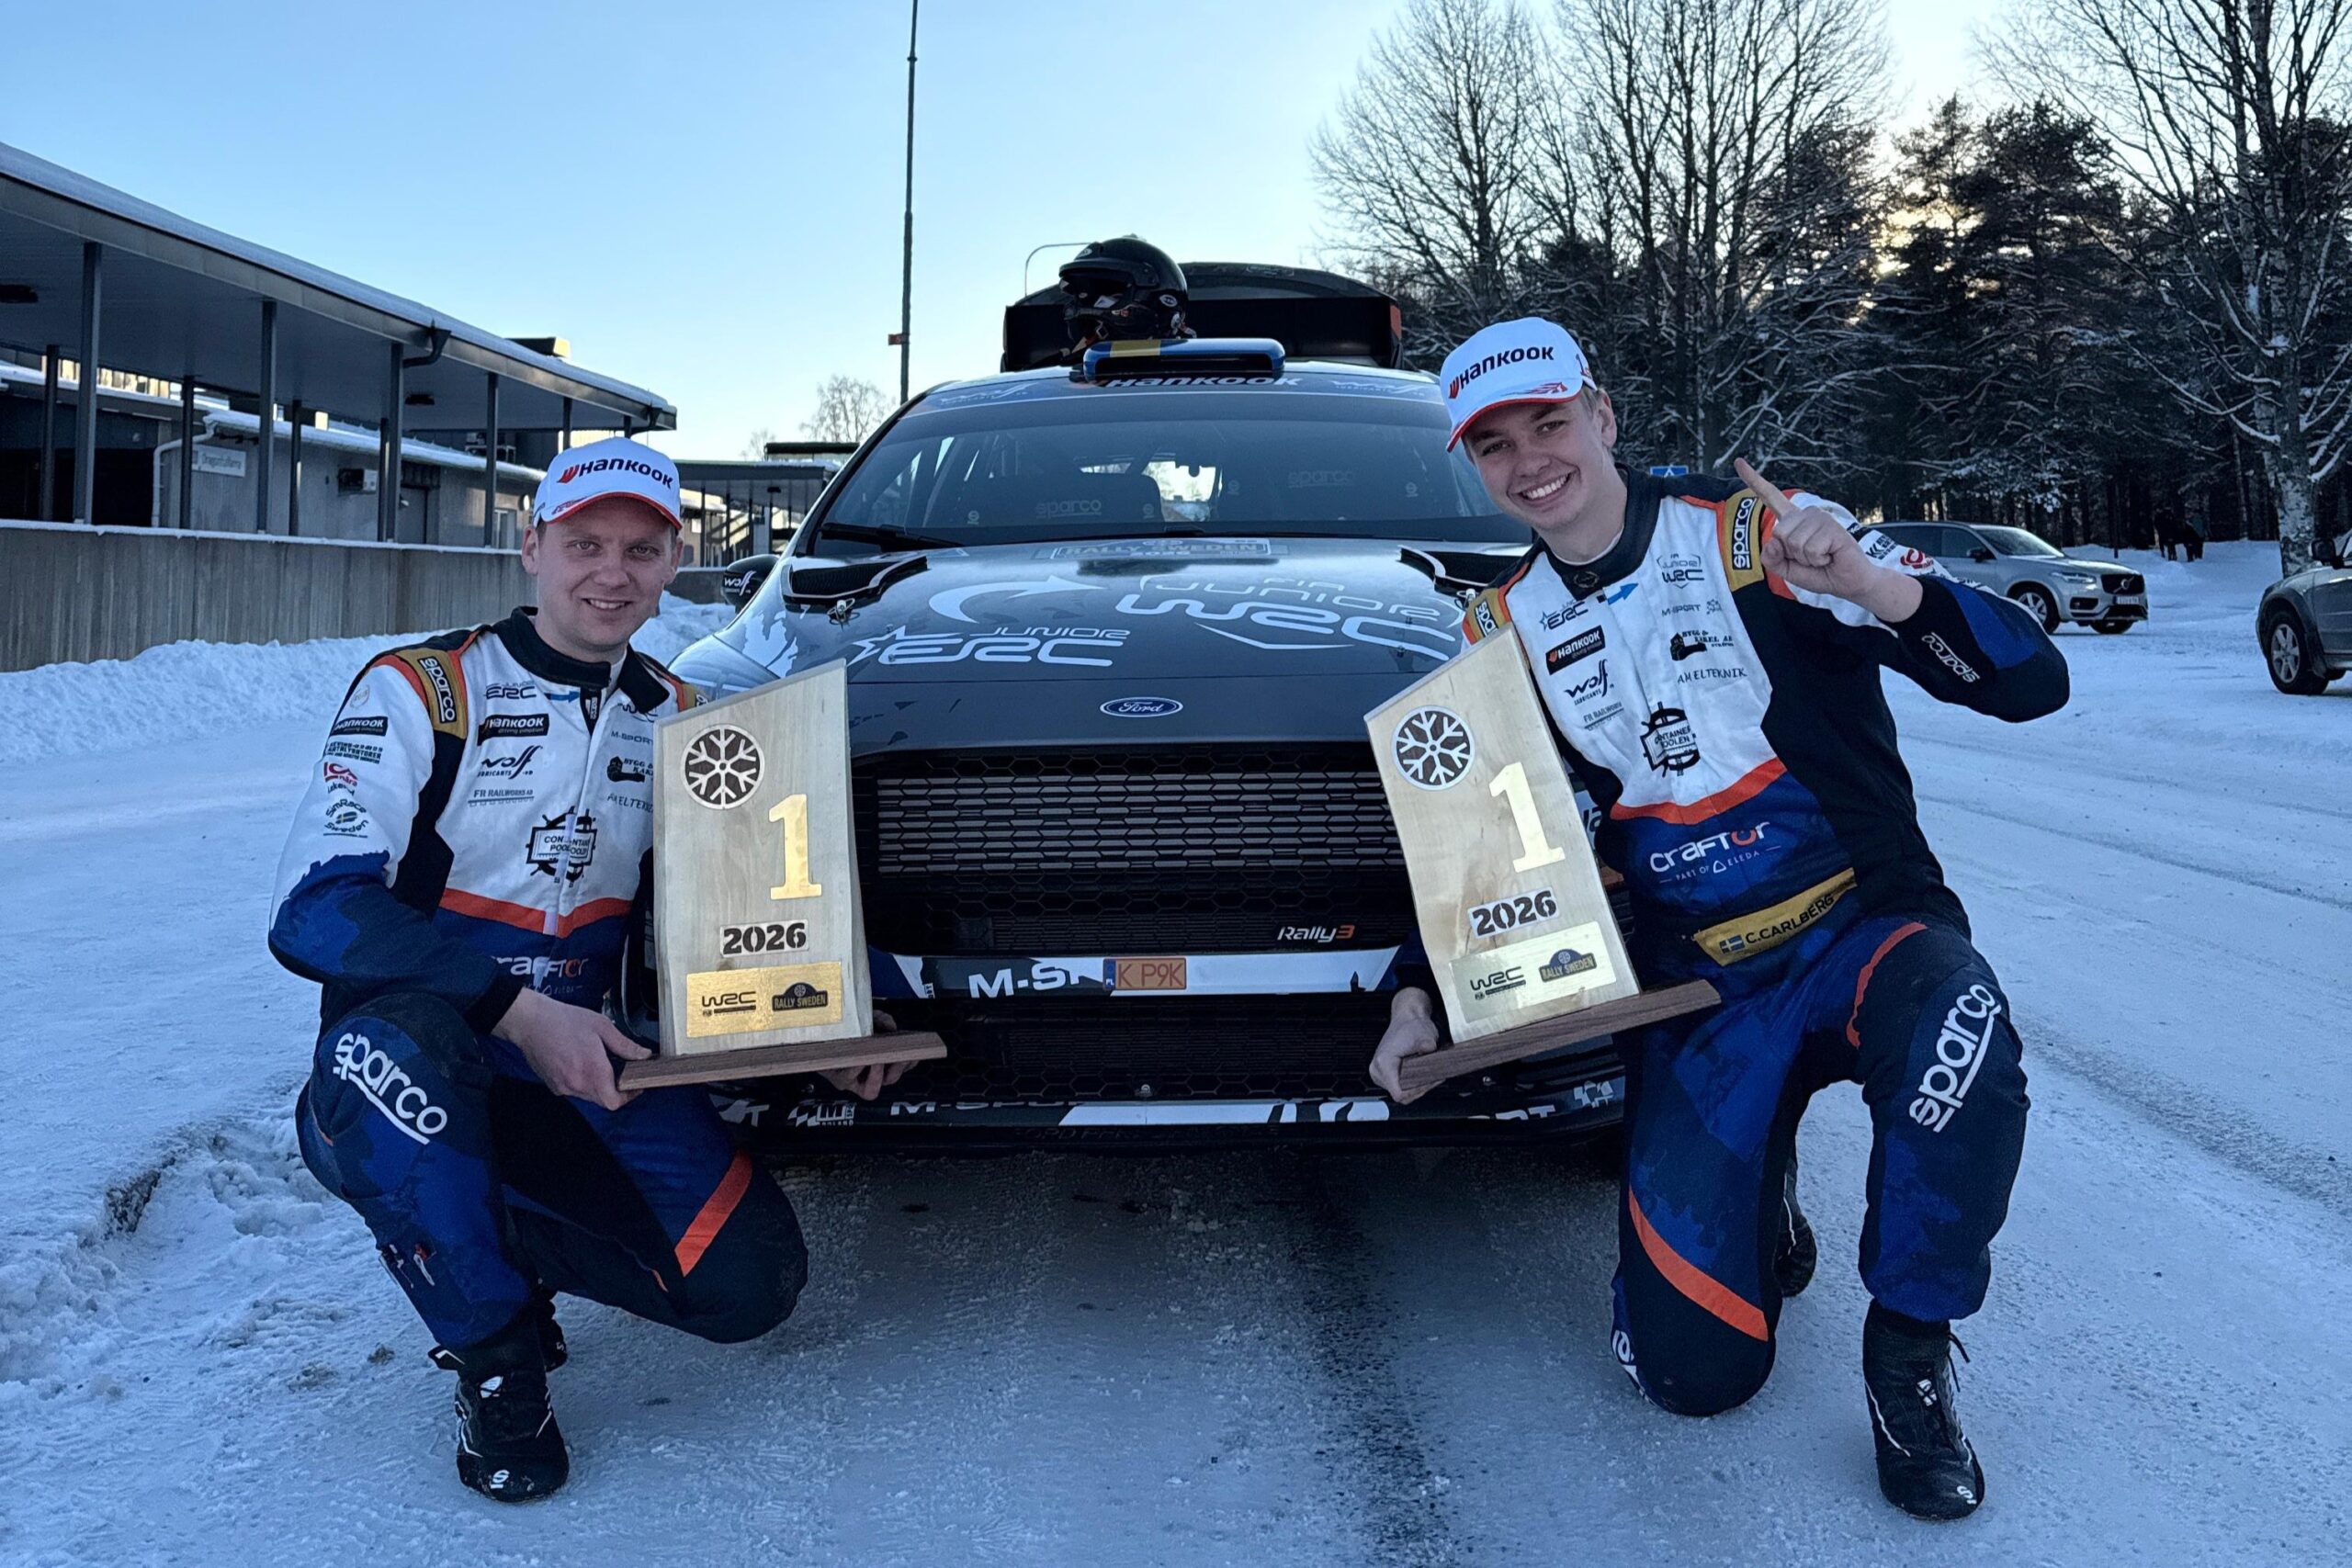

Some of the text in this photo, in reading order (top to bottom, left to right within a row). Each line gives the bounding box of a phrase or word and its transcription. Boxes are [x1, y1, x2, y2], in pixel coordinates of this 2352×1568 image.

[1036, 499, 1102, 519] sparco
[1734, 498, 1757, 569] sparco
[724, 570, 756, 596] wolf
[1661, 569, 1705, 583] WRC
[1155, 582, 1441, 622] JUNIOR
[1476, 602, 1498, 636] spa
[969, 626, 1131, 640] JUNIOR
[1114, 593, 1456, 661] WRC
[1921, 632, 1980, 682] sparco
[421, 657, 456, 722] sparco
[1564, 659, 1609, 698] wolf
[481, 744, 543, 780] wolf
[1489, 761, 1566, 873] 1
[769, 794, 822, 900] 1
[1727, 850, 1760, 867] ELEDA
[1472, 890, 1557, 936] 2026
[1746, 893, 1834, 944] C.CARLBERG
[722, 922, 807, 954] 2026
[1469, 965, 1524, 992] WRC
[701, 990, 757, 1008] WRC
[774, 994, 826, 1010] RALLY SWEDEN
[1909, 984, 2002, 1133] sparco
[332, 1032, 448, 1145] sparco
